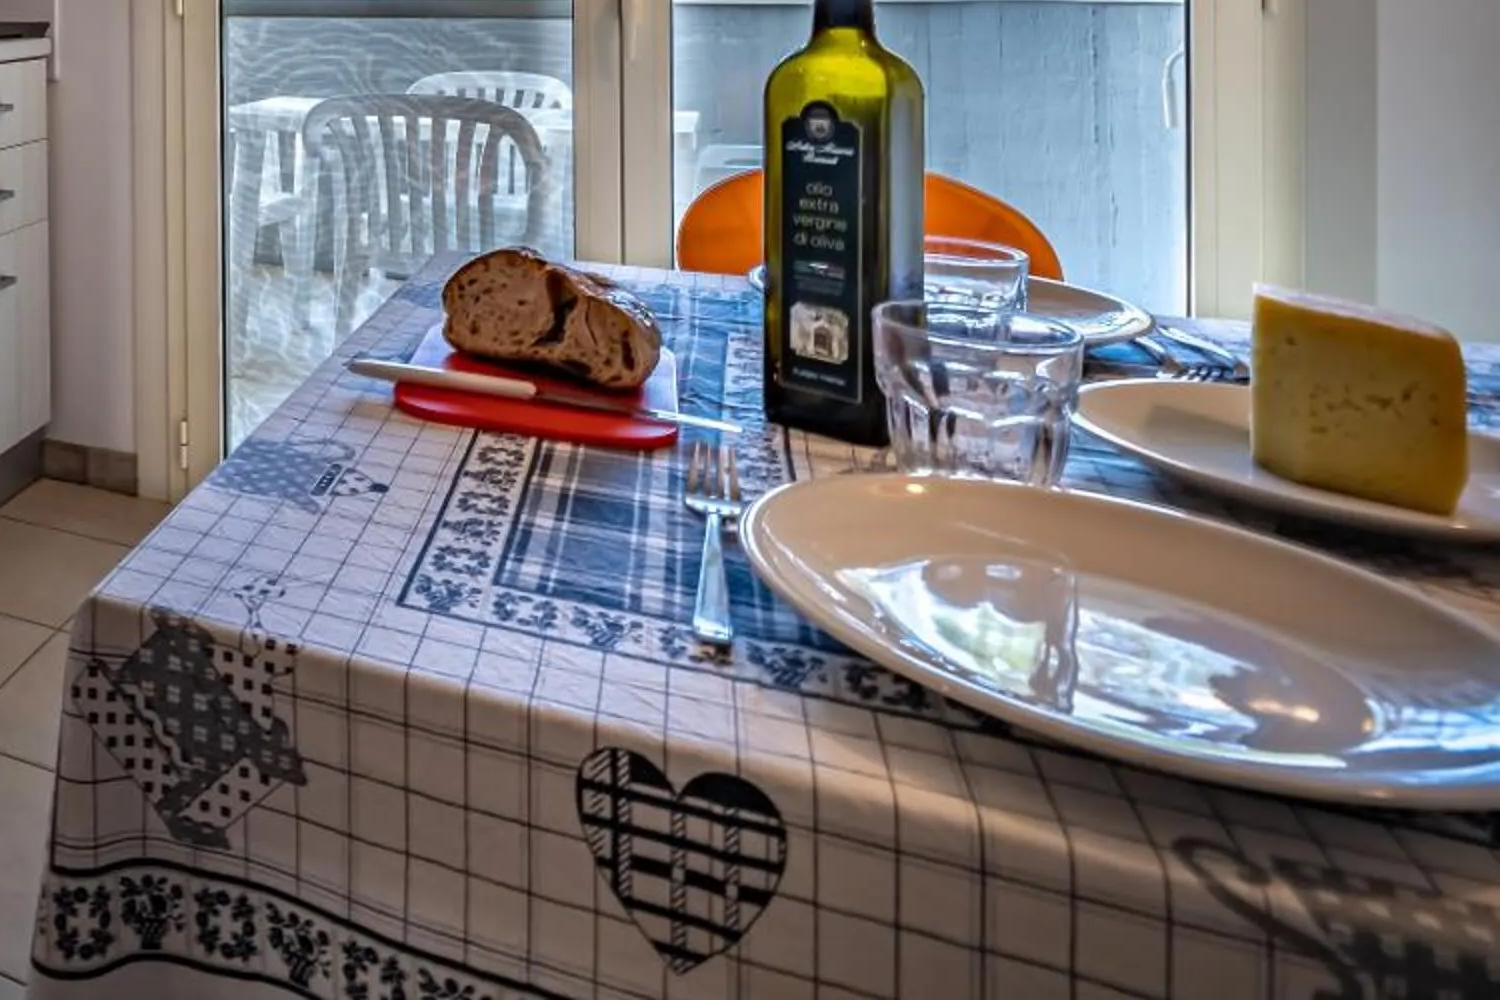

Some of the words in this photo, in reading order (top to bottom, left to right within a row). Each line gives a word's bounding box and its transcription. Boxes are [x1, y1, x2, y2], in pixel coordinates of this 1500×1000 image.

[805, 182, 833, 196] olio
[799, 198, 839, 214] extra
[792, 212, 848, 232] vergine
[810, 234, 845, 251] oliva
